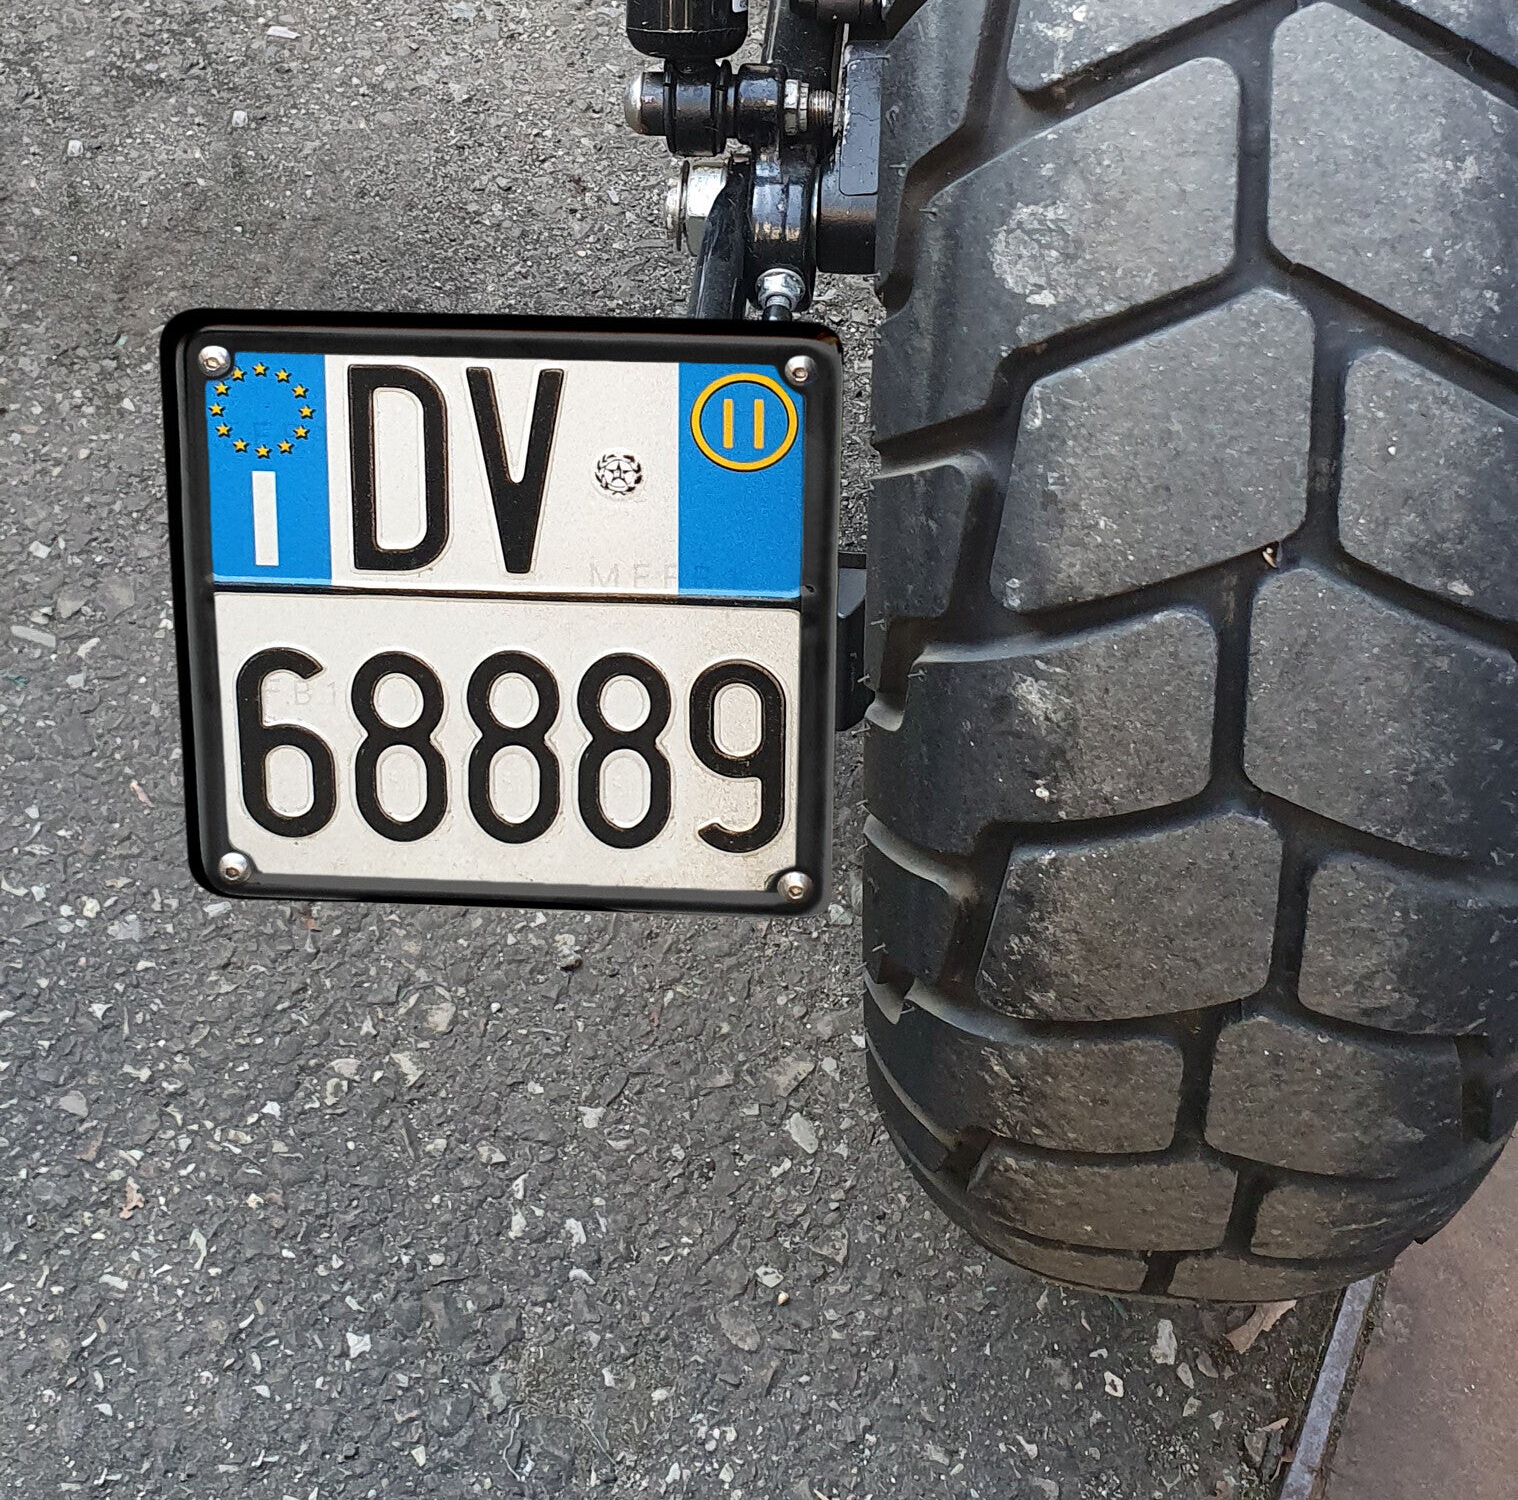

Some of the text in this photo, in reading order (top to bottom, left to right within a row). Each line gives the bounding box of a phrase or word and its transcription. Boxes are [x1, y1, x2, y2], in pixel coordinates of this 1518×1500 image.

[251, 470, 279, 567] I
[346, 364, 565, 575] DV
[235, 646, 787, 854] 68889
